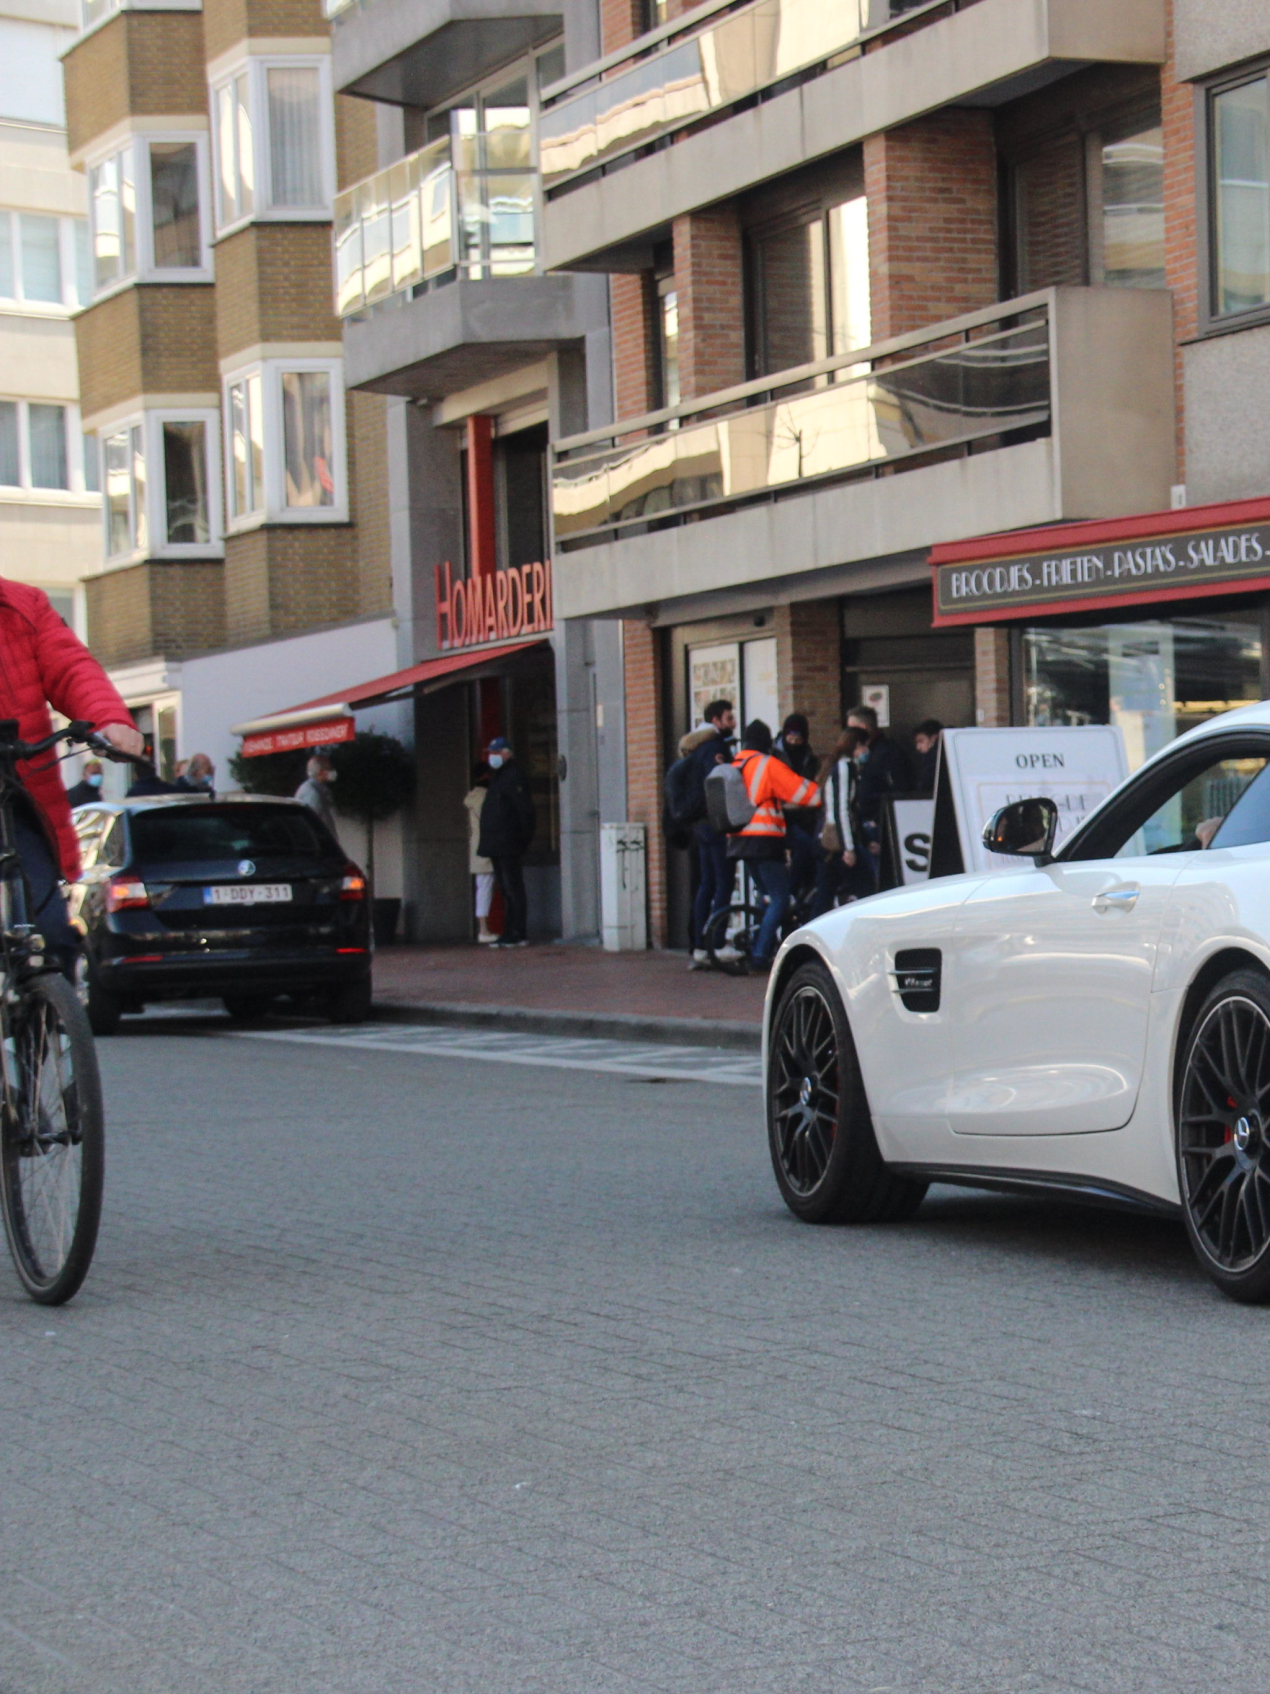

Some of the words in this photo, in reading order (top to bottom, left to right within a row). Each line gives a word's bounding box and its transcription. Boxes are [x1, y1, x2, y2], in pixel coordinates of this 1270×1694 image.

[951, 562, 1033, 598] BROODJES
[1042, 554, 1104, 588] FRIETEN
[1114, 543, 1176, 578] PASTA'S
[1186, 532, 1262, 570] SALADES
[1015, 753, 1066, 769] OPEN
